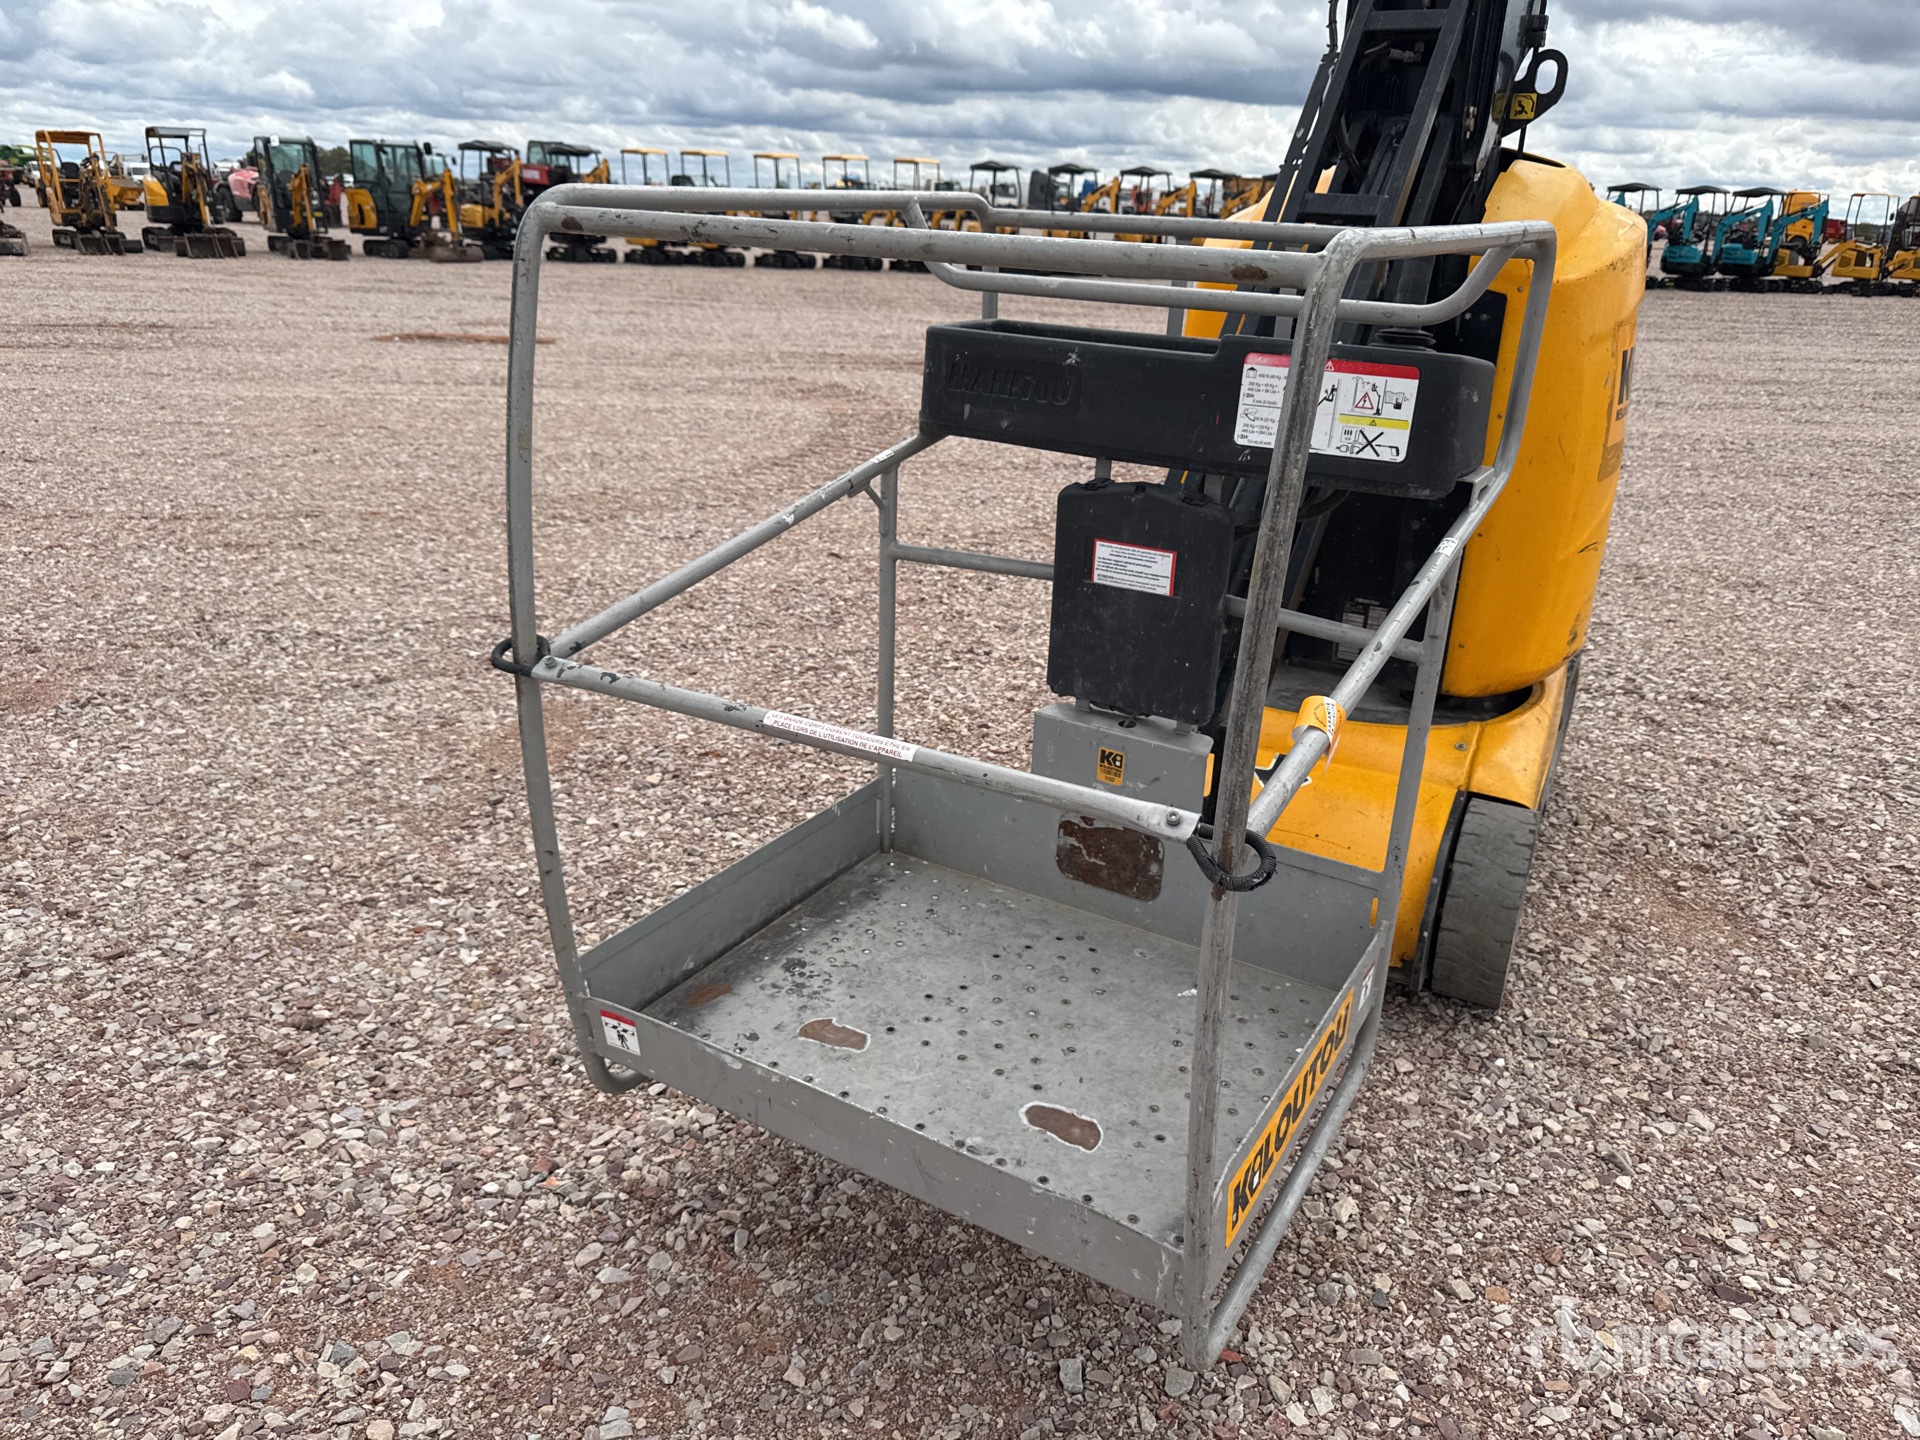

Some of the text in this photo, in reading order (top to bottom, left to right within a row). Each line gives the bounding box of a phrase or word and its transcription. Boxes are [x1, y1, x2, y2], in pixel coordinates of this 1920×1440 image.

[948, 363, 1077, 406] MANITOU
[773, 720, 792, 730] PLACE
[793, 725, 808, 733] LORS
[868, 744, 902, 757] L'APPAREIL
[852, 733, 884, 744] TOUJOURS
